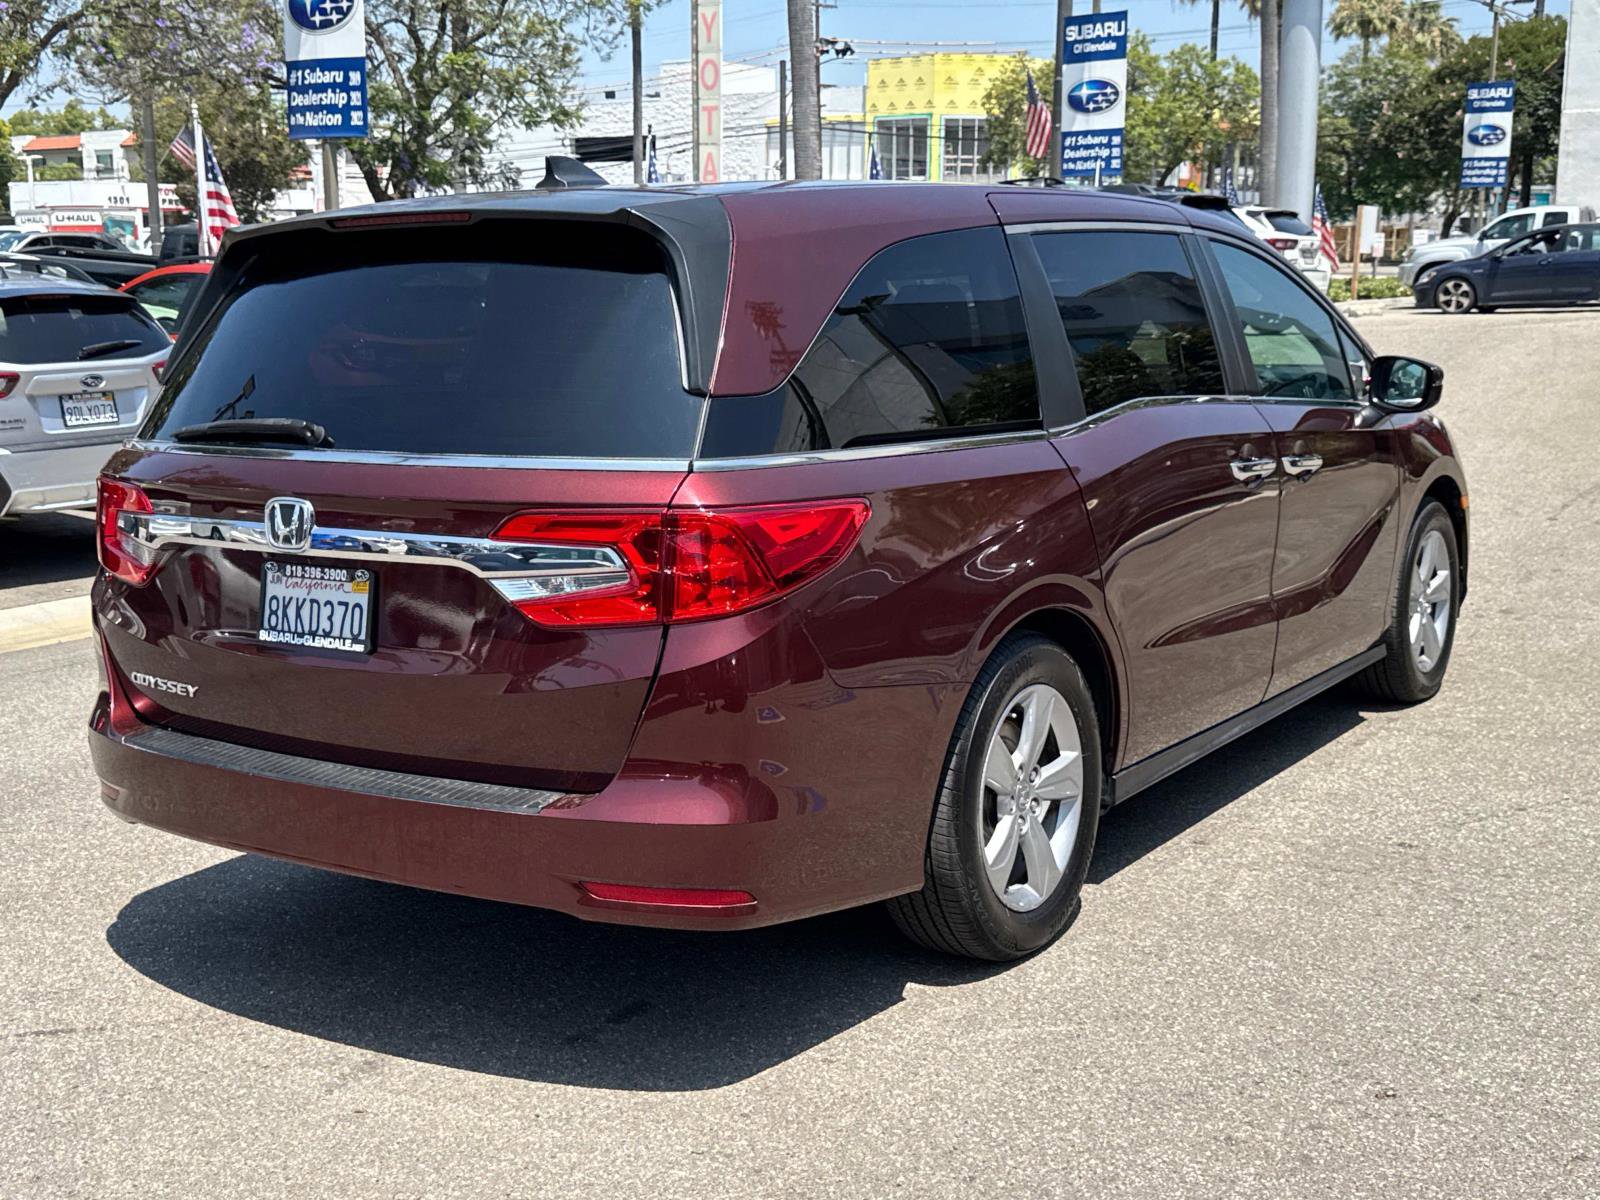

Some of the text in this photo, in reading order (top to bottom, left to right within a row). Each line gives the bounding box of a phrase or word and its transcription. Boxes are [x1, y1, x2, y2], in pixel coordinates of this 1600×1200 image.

[1065, 21, 1126, 42] SUBARU
[1083, 41, 1117, 53] Glendale
[290, 67, 344, 86] #1 Subaru
[290, 88, 348, 109] Dealership
[1467, 87, 1513, 100] SUBARU
[305, 110, 343, 127] Nation
[1076, 134, 1109, 146] Subaru
[1063, 146, 1110, 159] Dealership
[55, 214, 97, 222] U-HAUL
[285, 565, 348, 581] 818-396-3900
[284, 577, 354, 596] California
[267, 594, 364, 640] 8KKD370
[130, 671, 200, 699] ODYSSEY
